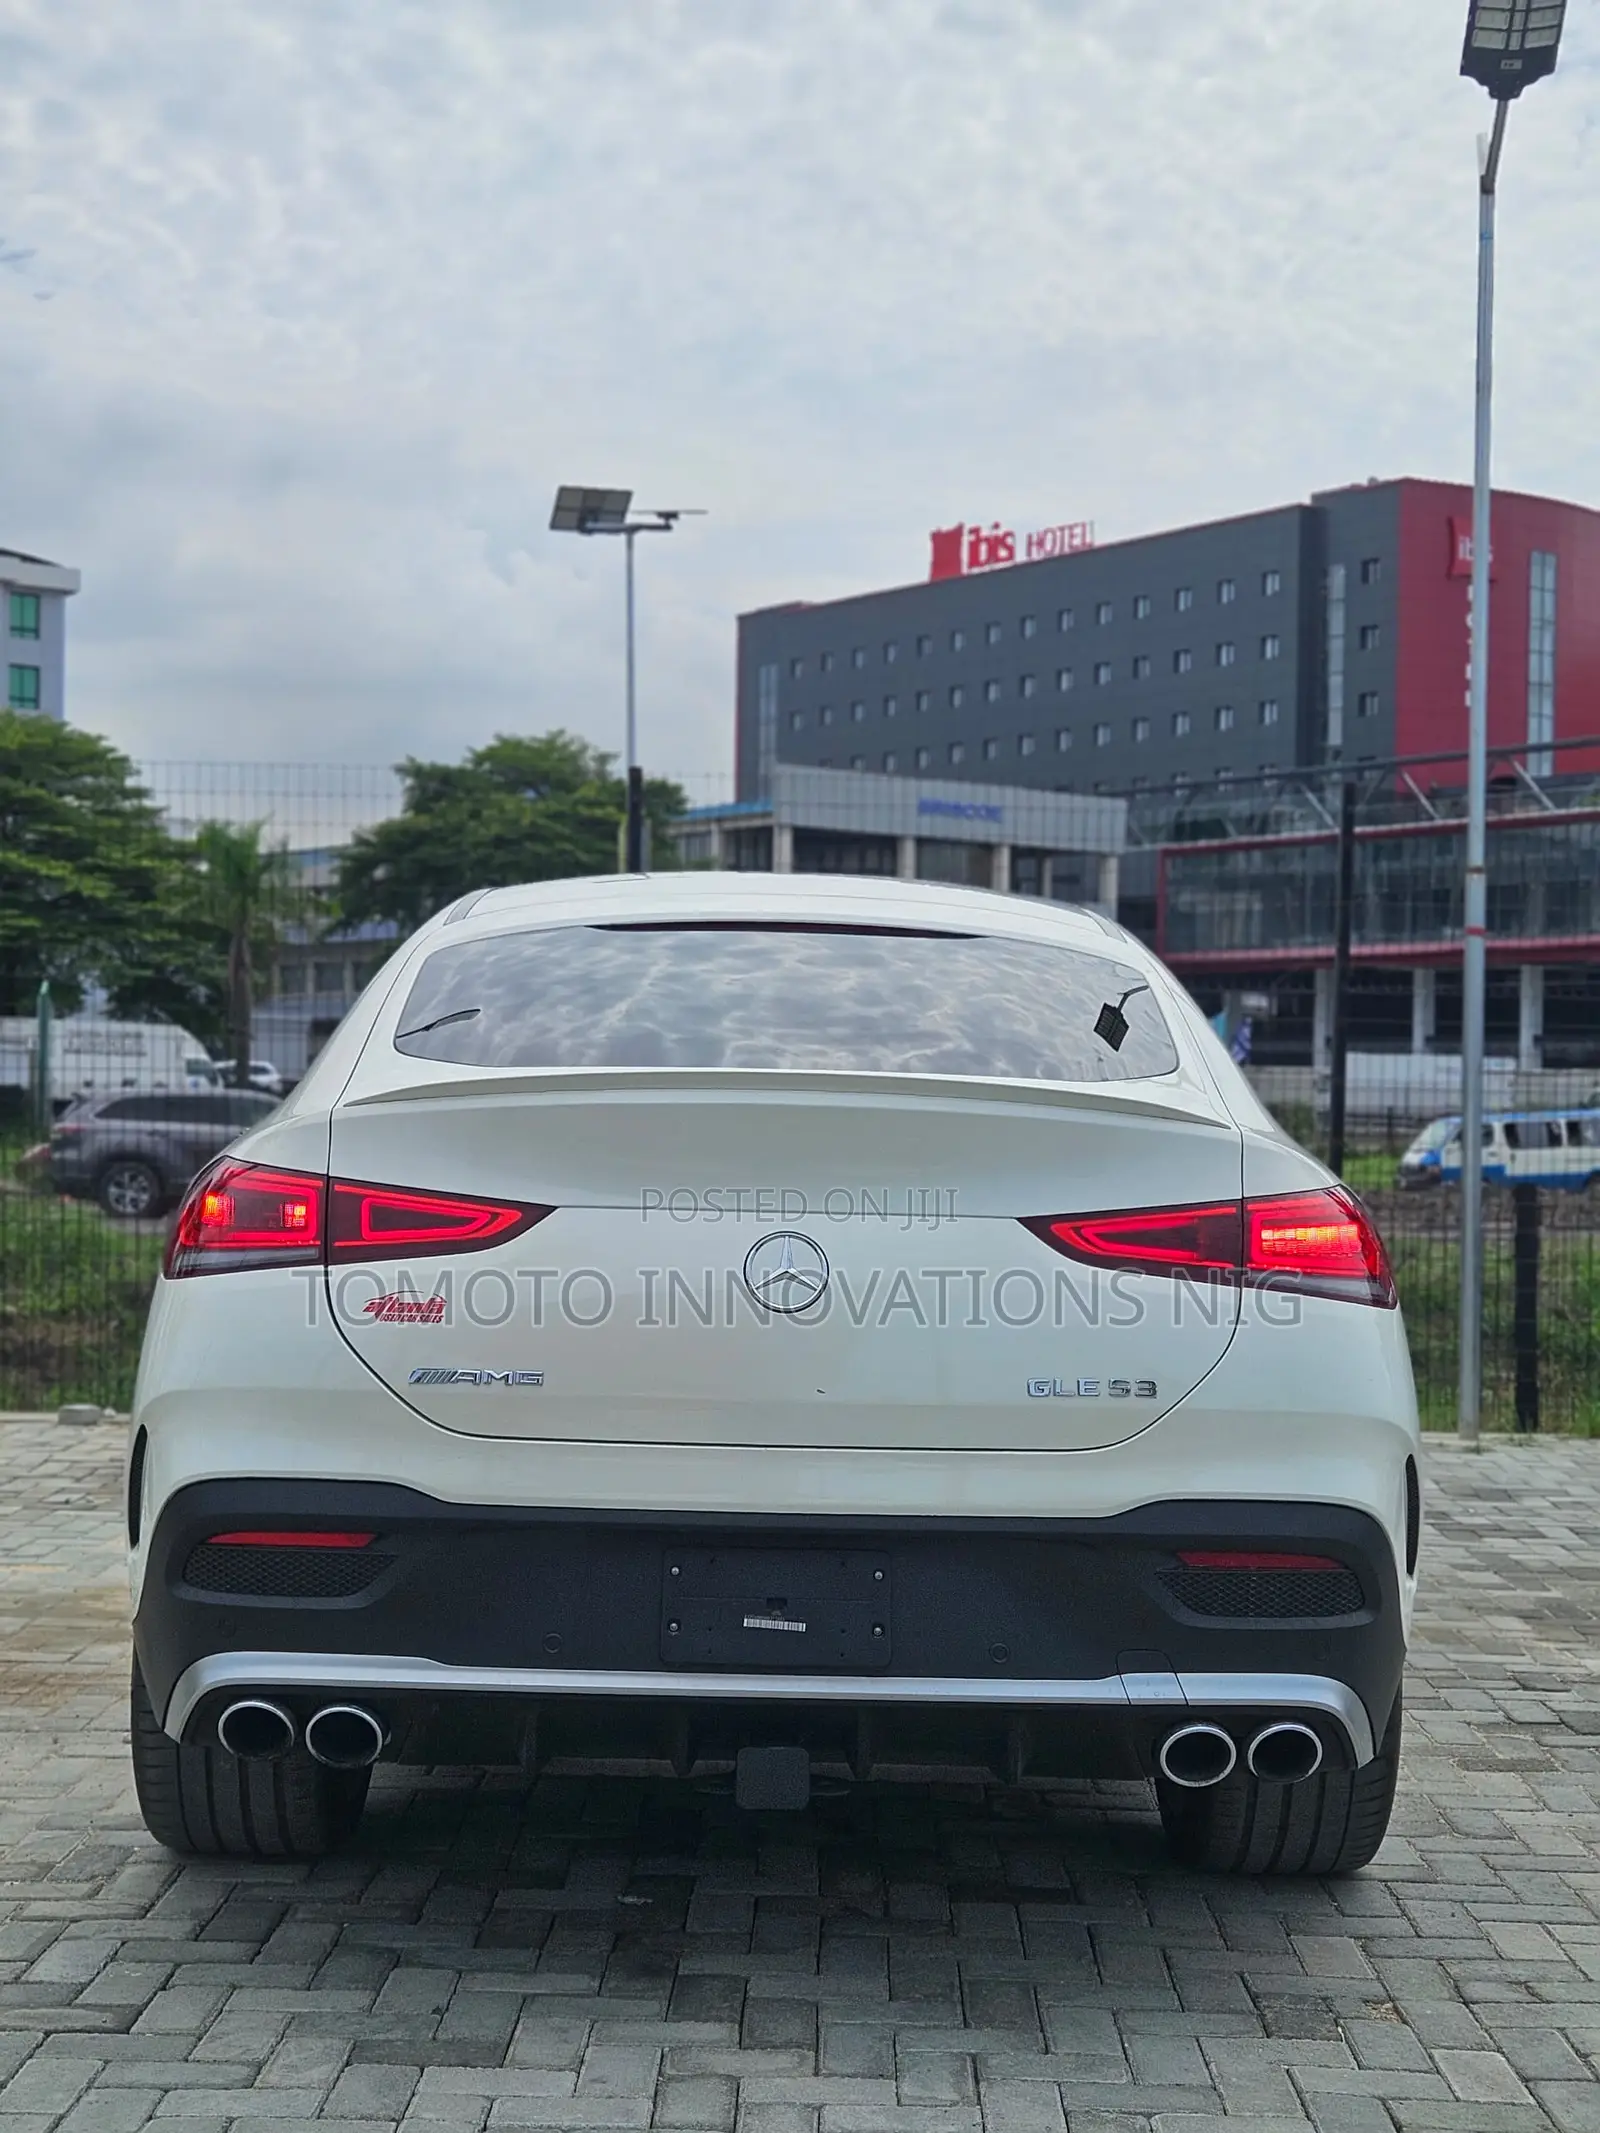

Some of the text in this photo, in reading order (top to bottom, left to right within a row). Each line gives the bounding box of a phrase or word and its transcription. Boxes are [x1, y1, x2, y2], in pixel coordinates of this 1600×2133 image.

[967, 521, 1092, 569] ibis HOTEL
[450, 1369, 544, 1386] AMG
[1027, 1377, 1158, 1398] GLE 53
